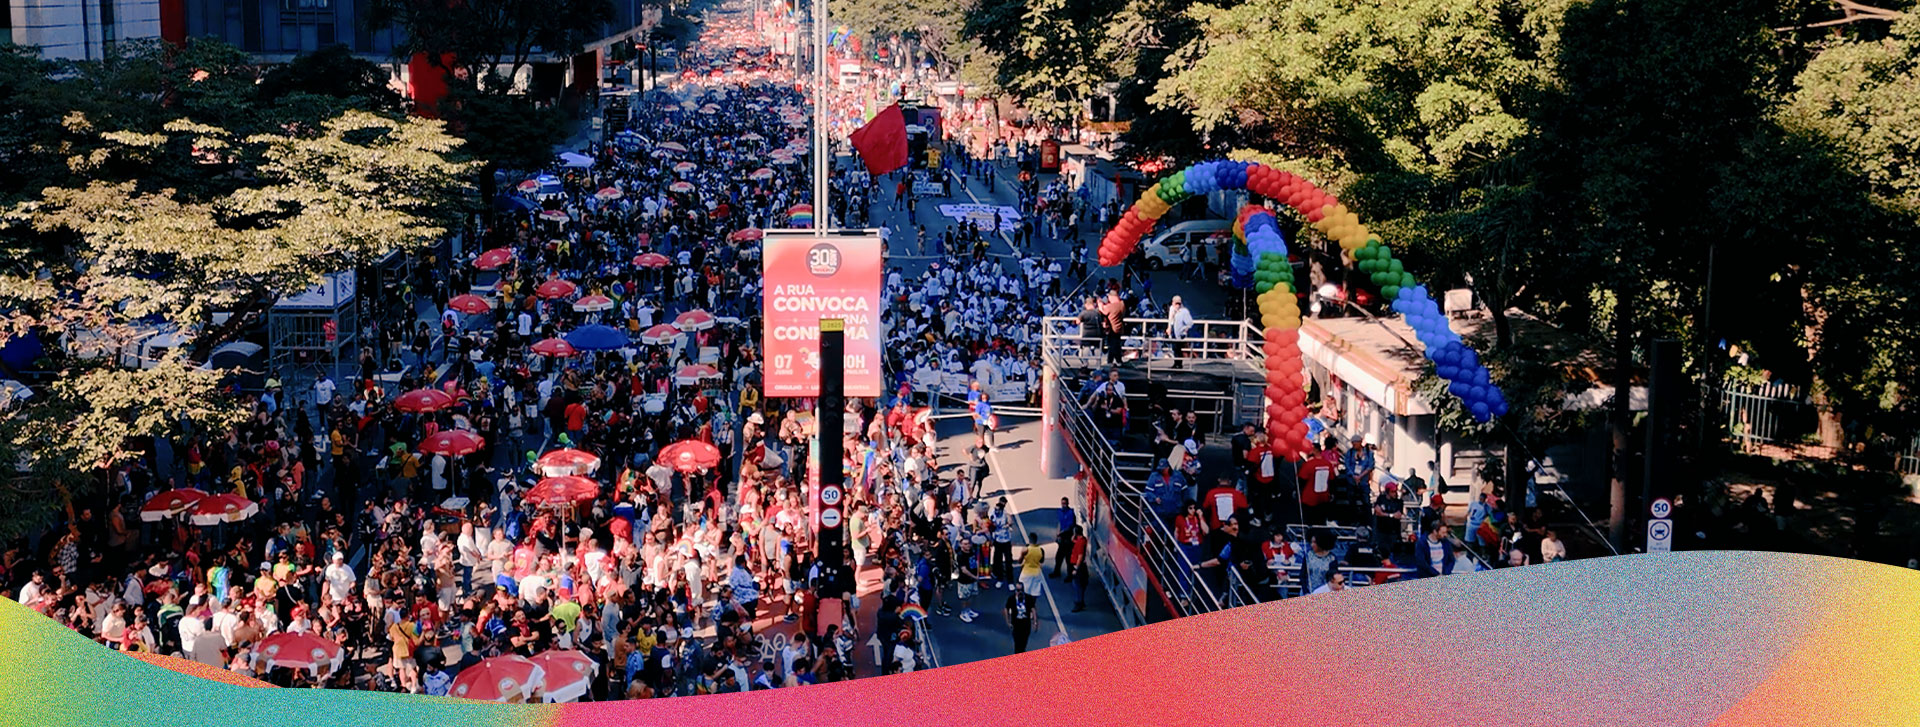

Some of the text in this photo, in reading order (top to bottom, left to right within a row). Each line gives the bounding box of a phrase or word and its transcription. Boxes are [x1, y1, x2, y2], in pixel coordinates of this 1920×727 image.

[810, 249, 829, 265] 30
[317, 286, 325, 296] 4
[774, 285, 815, 295] A RUA
[774, 297, 869, 312] CONVOCA
[774, 326, 869, 340] CONFMA
[775, 355, 793, 368] 07
[824, 490, 838, 500] 50
[1654, 503, 1668, 512] 50
